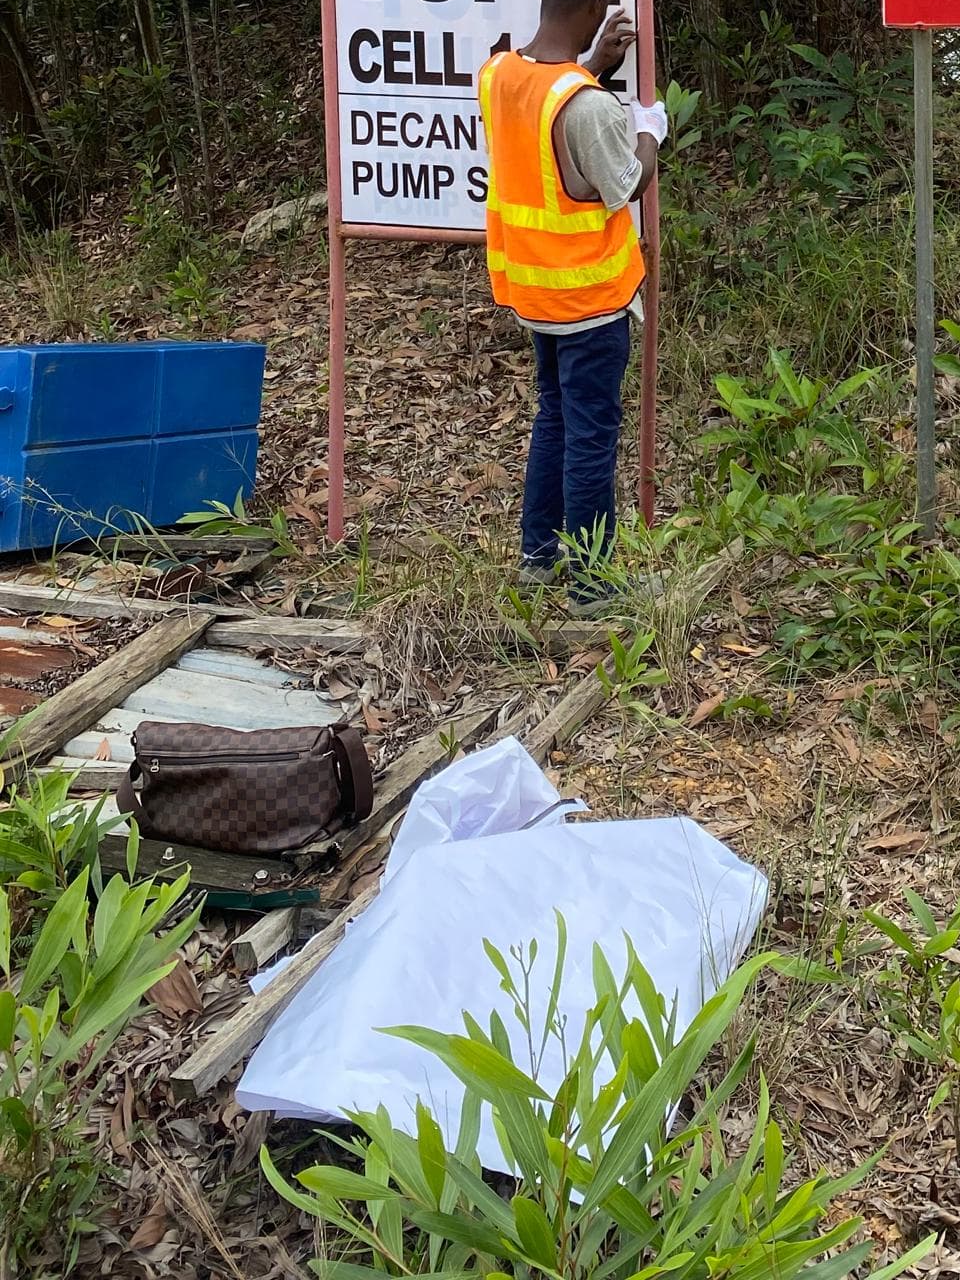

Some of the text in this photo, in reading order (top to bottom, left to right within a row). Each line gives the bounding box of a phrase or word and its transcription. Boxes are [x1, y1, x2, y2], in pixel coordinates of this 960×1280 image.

[348, 28, 473, 87] CELL
[350, 110, 485, 151] DECAN
[352, 160, 455, 200] PUMP
